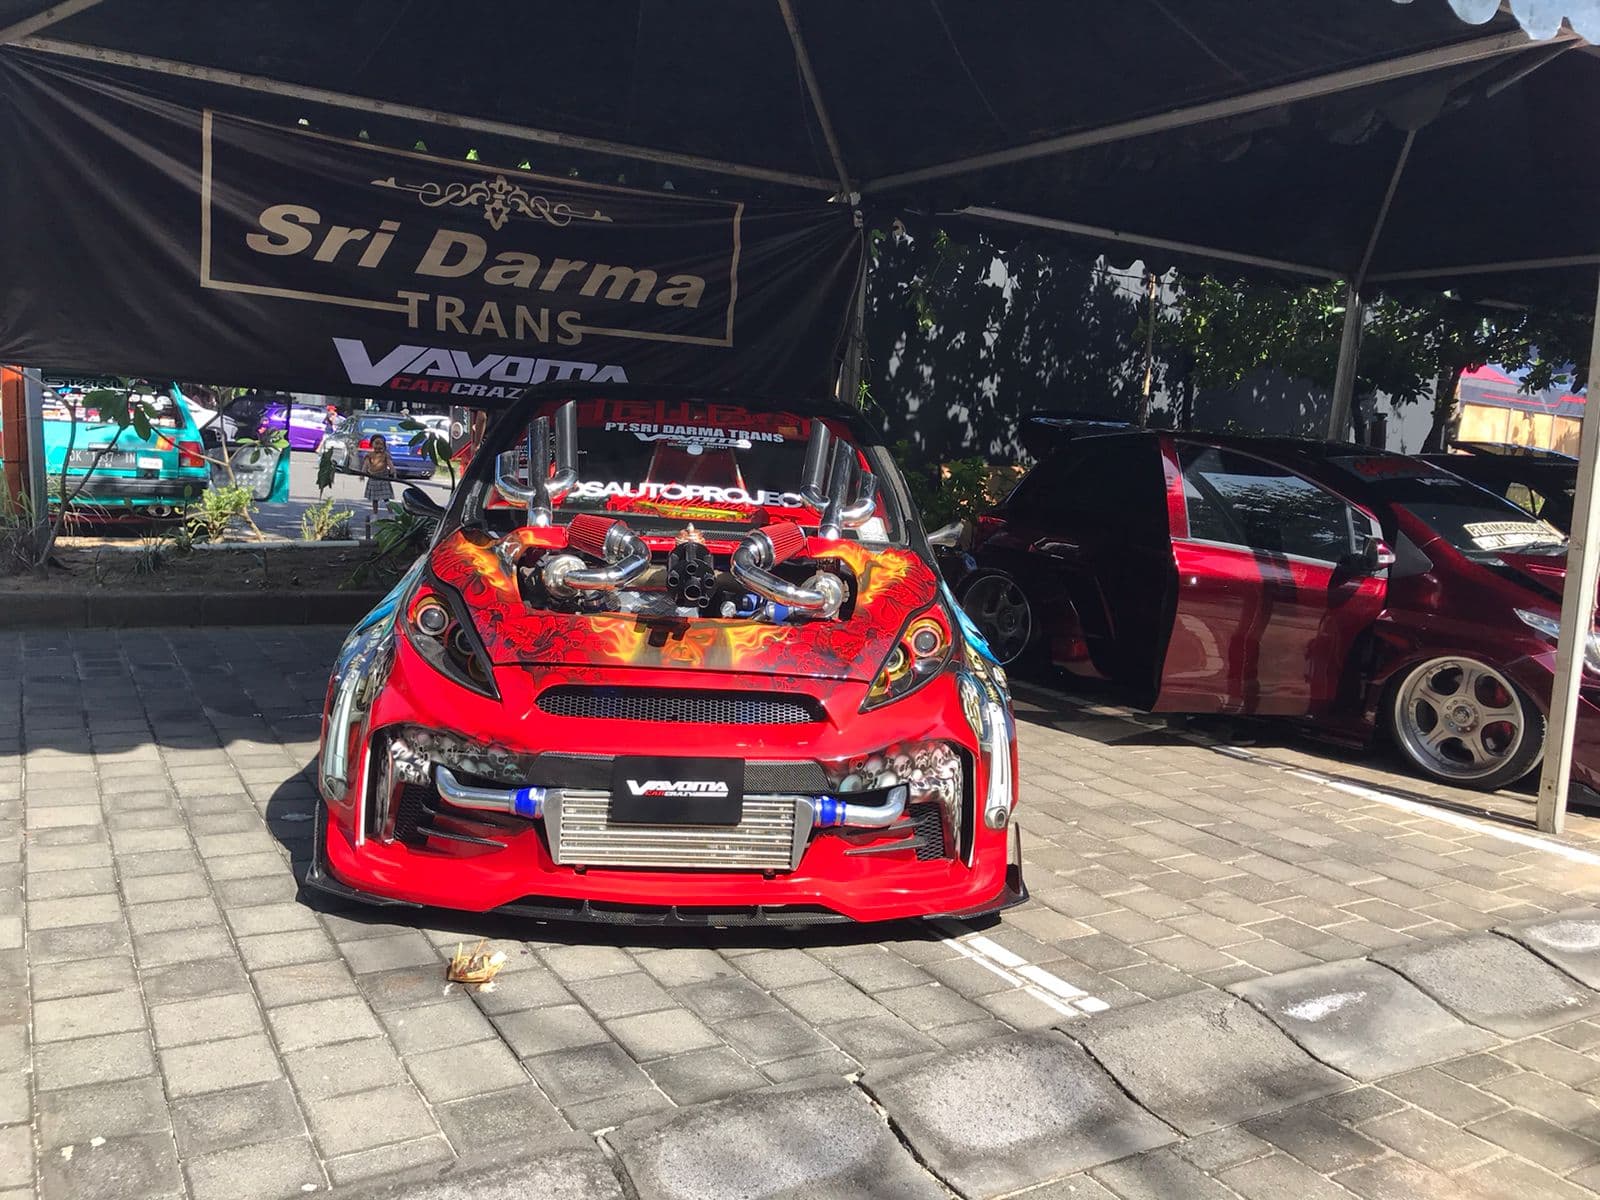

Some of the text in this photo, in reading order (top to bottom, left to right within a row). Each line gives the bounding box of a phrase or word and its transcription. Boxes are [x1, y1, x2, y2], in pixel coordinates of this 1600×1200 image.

[246, 204, 706, 310] Sri Darma
[397, 290, 583, 346] TRANS
[332, 337, 629, 387] VAVOMA
[662, 424, 728, 437] DARMA
[730, 429, 784, 443] TRANS
[566, 480, 802, 509] OSAUTOPROJEC
[626, 779, 729, 796] VAVOMA
